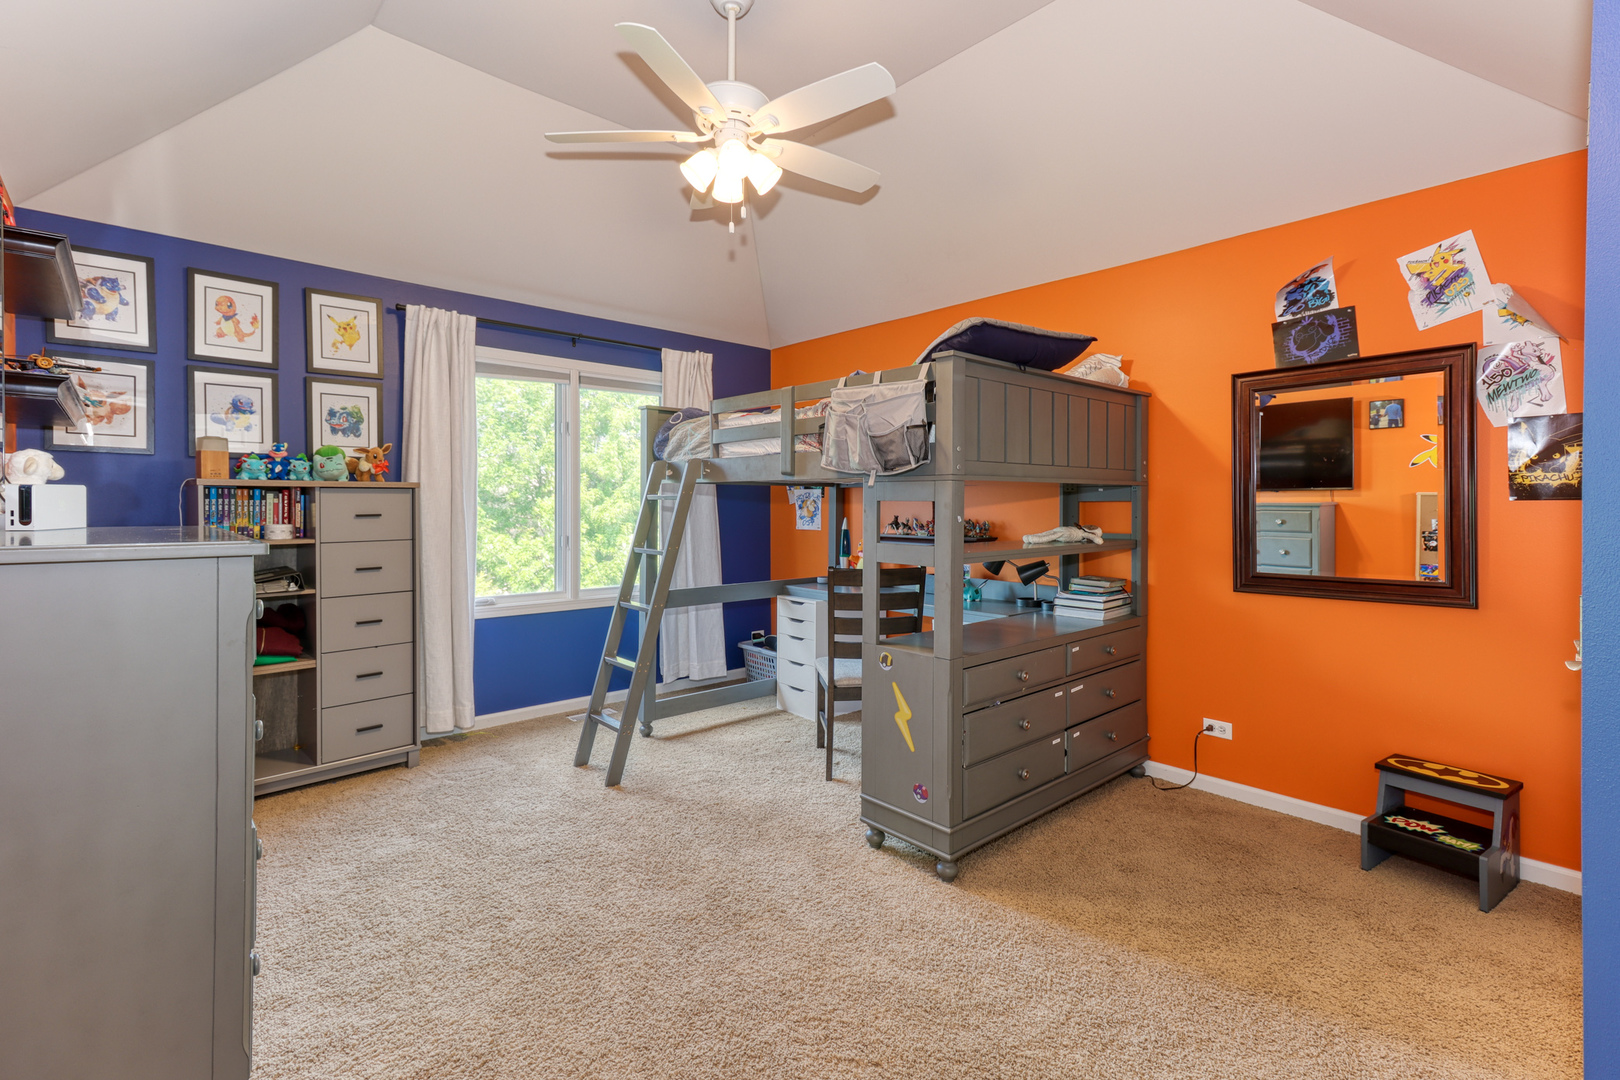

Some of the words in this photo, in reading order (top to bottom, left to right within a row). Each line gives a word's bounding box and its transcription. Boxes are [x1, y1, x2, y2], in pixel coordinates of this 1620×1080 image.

[1444, 277, 1469, 296] 025
[1481, 367, 1512, 390] 150
[1488, 368, 1538, 404] MEWTWO
[1521, 472, 1574, 483] PIKACHU
[1391, 817, 1440, 832] POW
